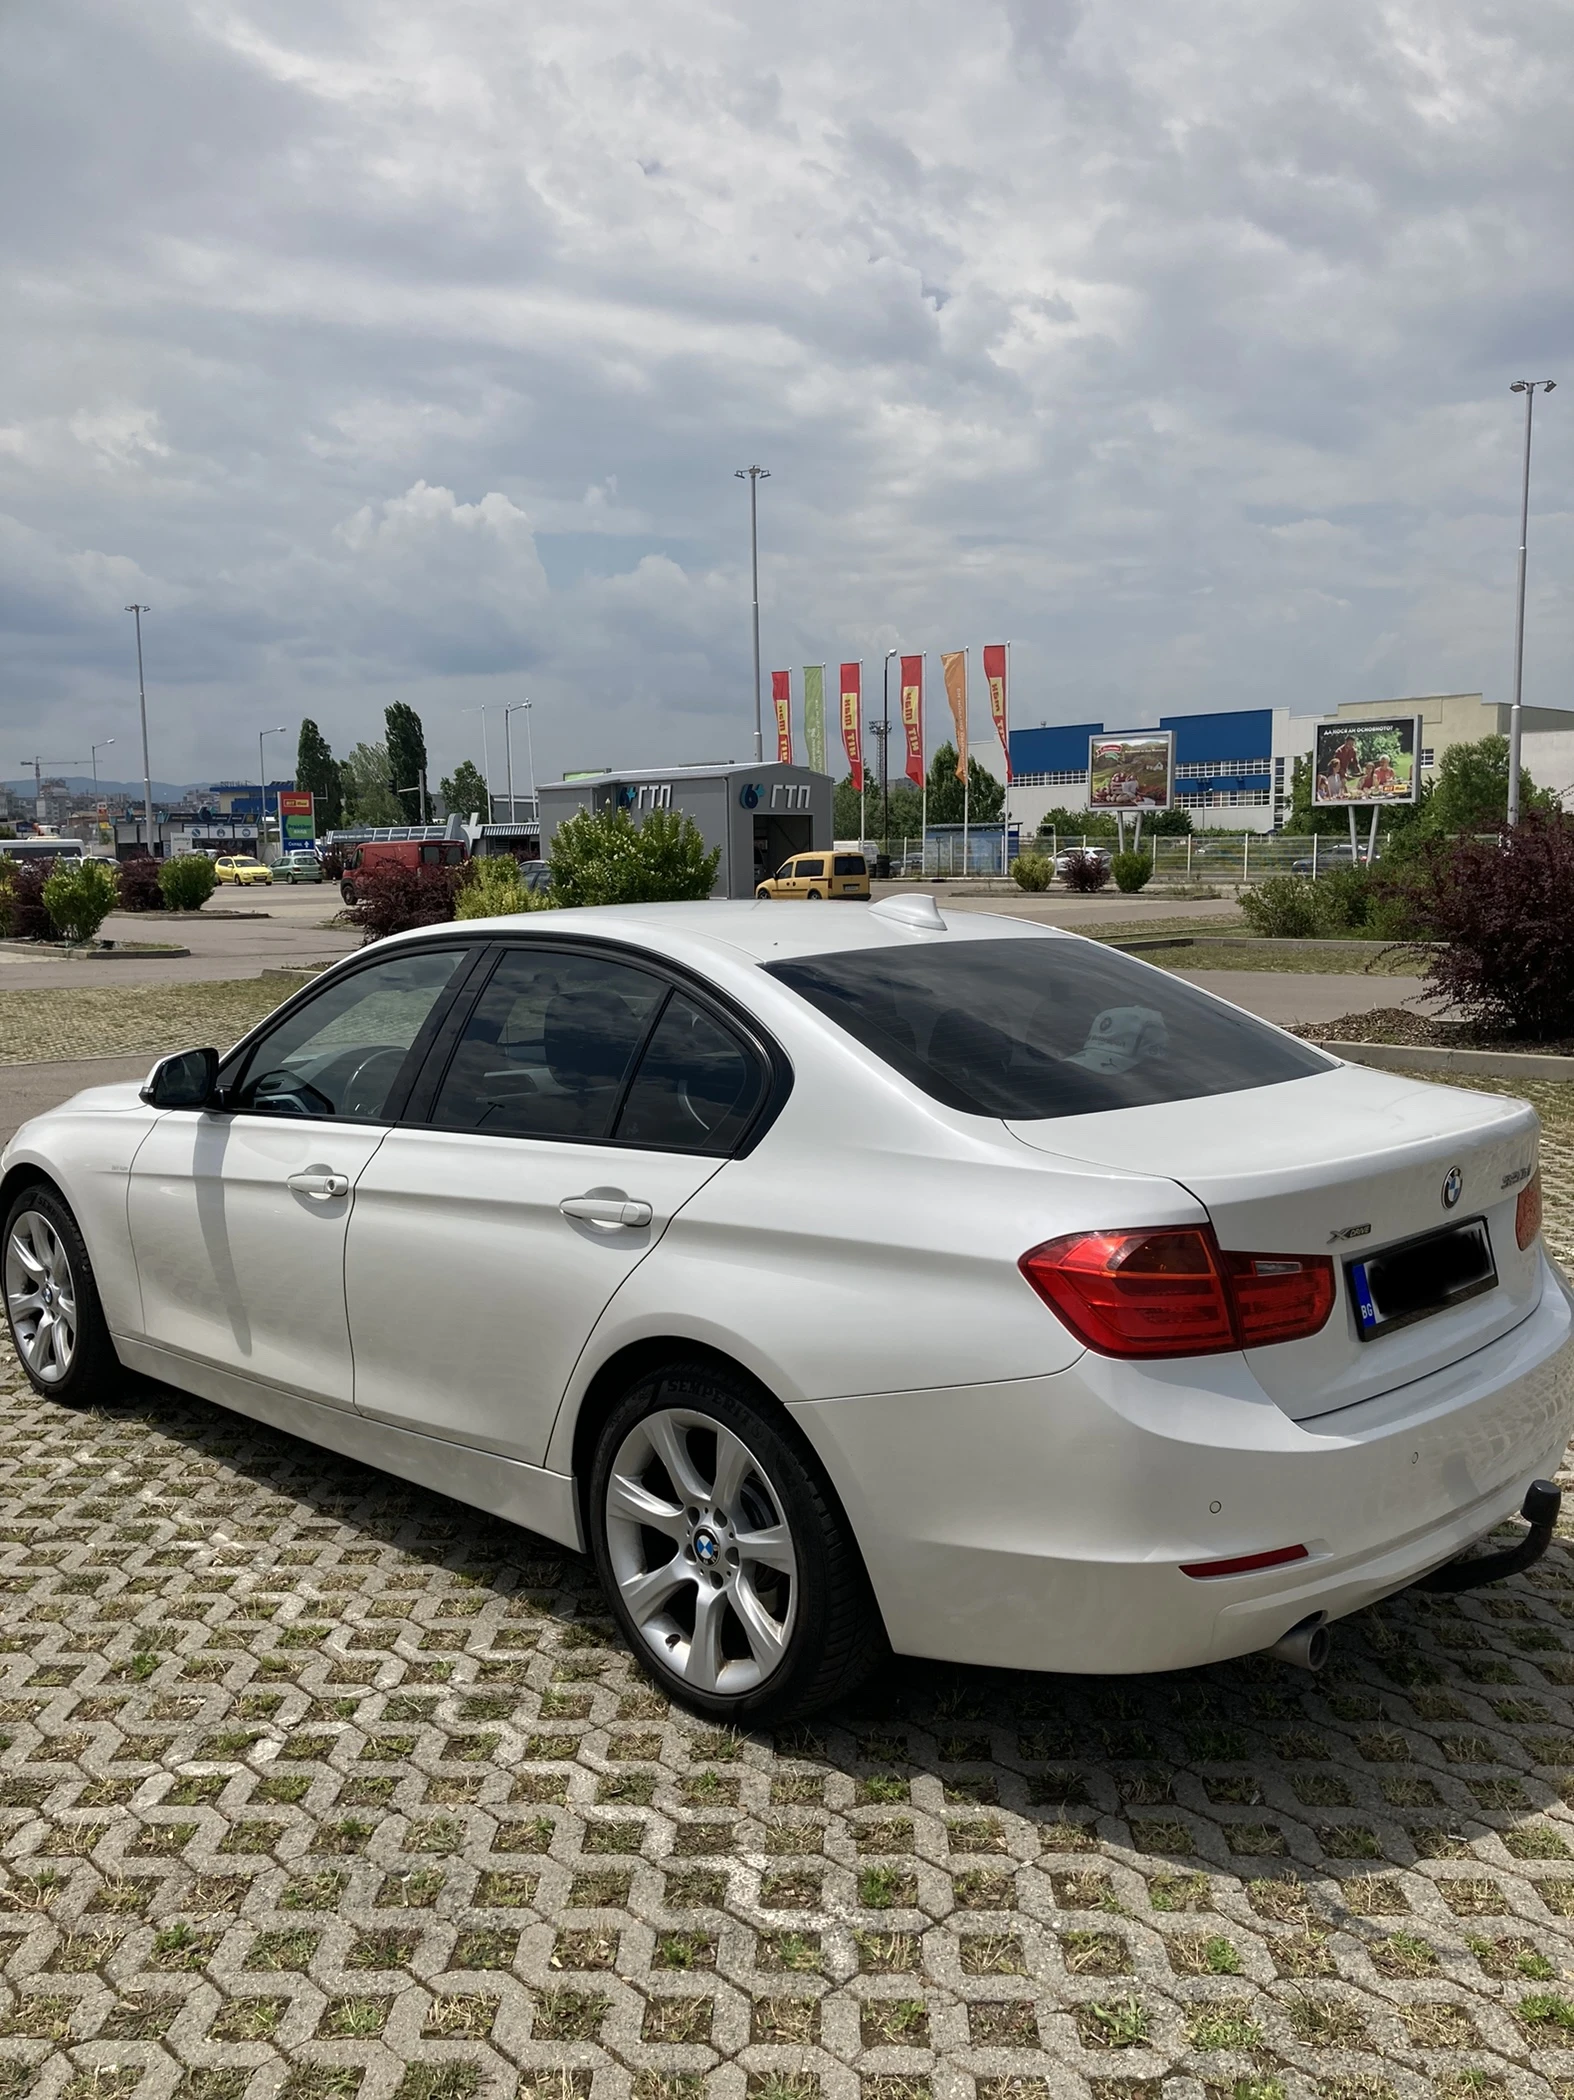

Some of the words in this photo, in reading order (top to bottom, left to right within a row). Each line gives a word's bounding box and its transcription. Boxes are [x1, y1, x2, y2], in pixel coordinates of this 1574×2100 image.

[638, 784, 672, 809] ГТП
[770, 784, 811, 809] ГТП
[1361, 1303, 1373, 1319] BG
